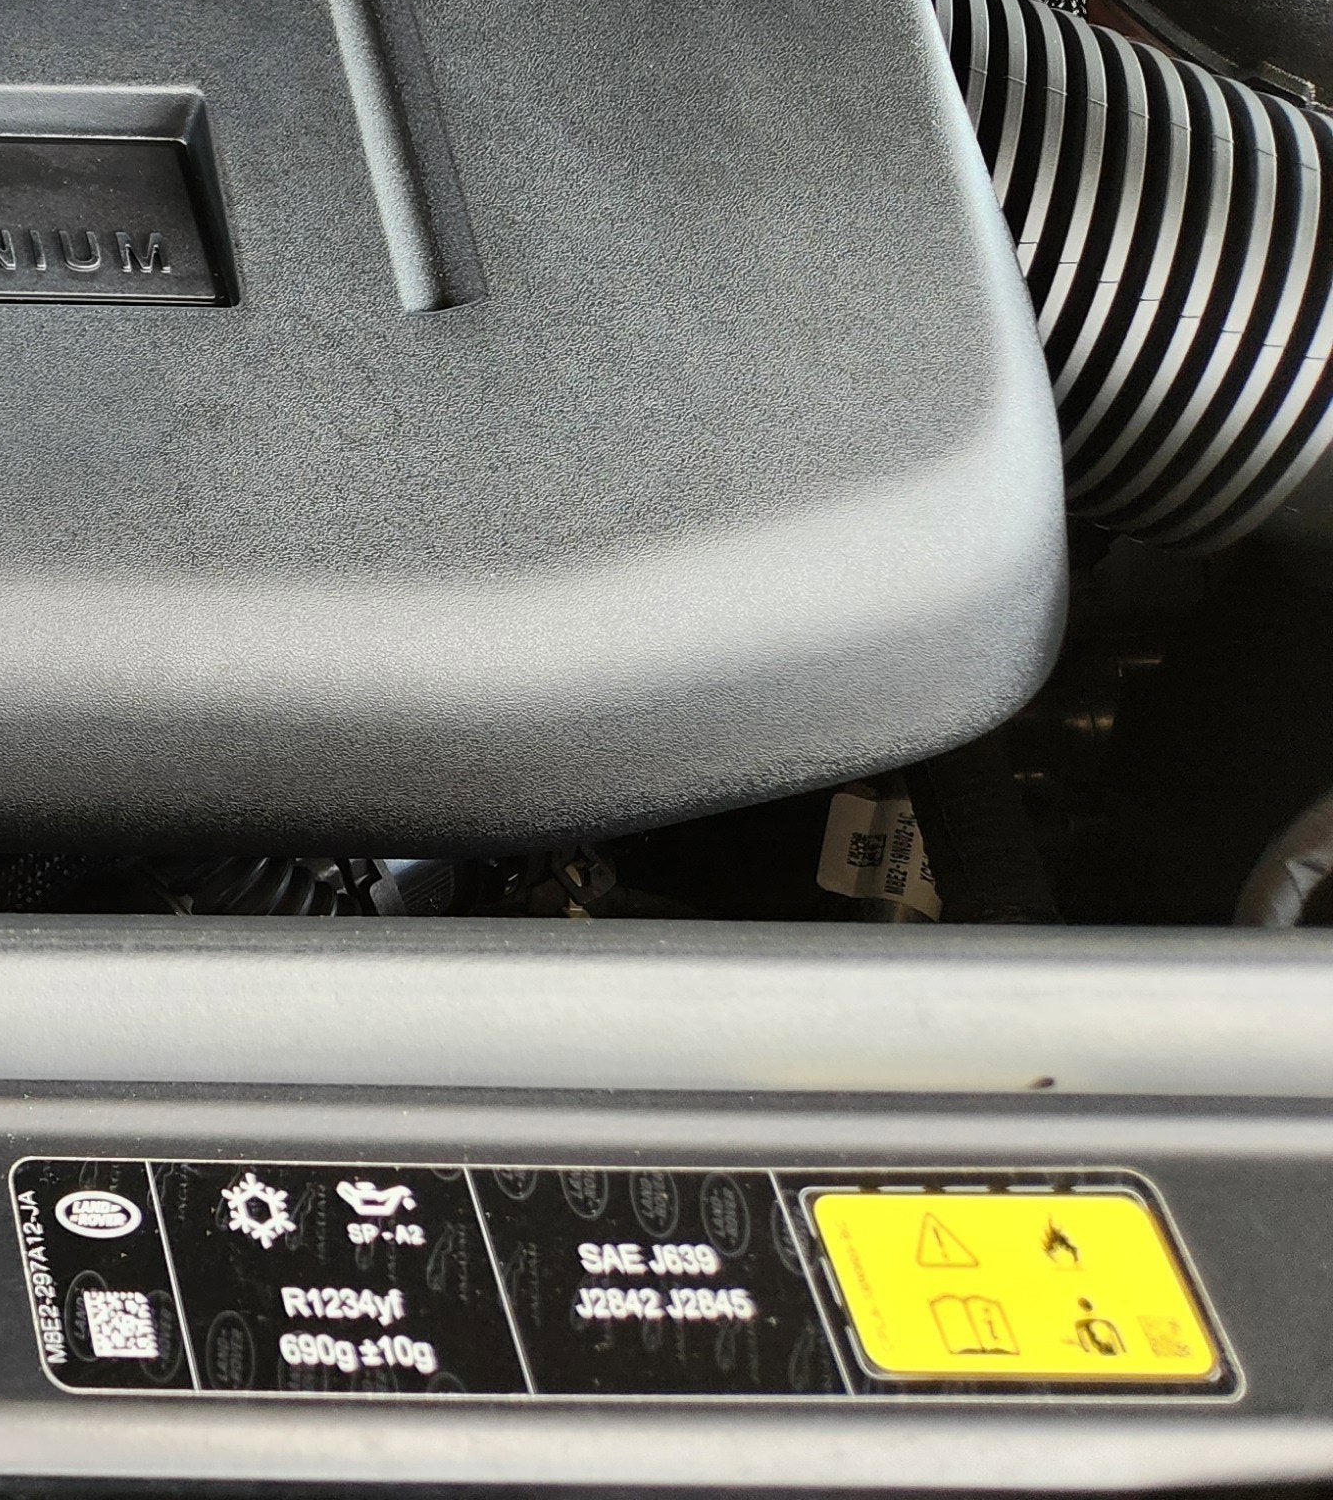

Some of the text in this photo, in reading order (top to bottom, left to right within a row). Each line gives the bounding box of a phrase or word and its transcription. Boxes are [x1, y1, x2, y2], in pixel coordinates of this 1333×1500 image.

[17, 1190, 68, 1365] M8E2-297A12-JA
[577, 1243, 721, 1275] SAE J639
[280, 1286, 406, 1326] R1234yf
[575, 1287, 758, 1321] J2842 J2845
[279, 1333, 359, 1374] 690g
